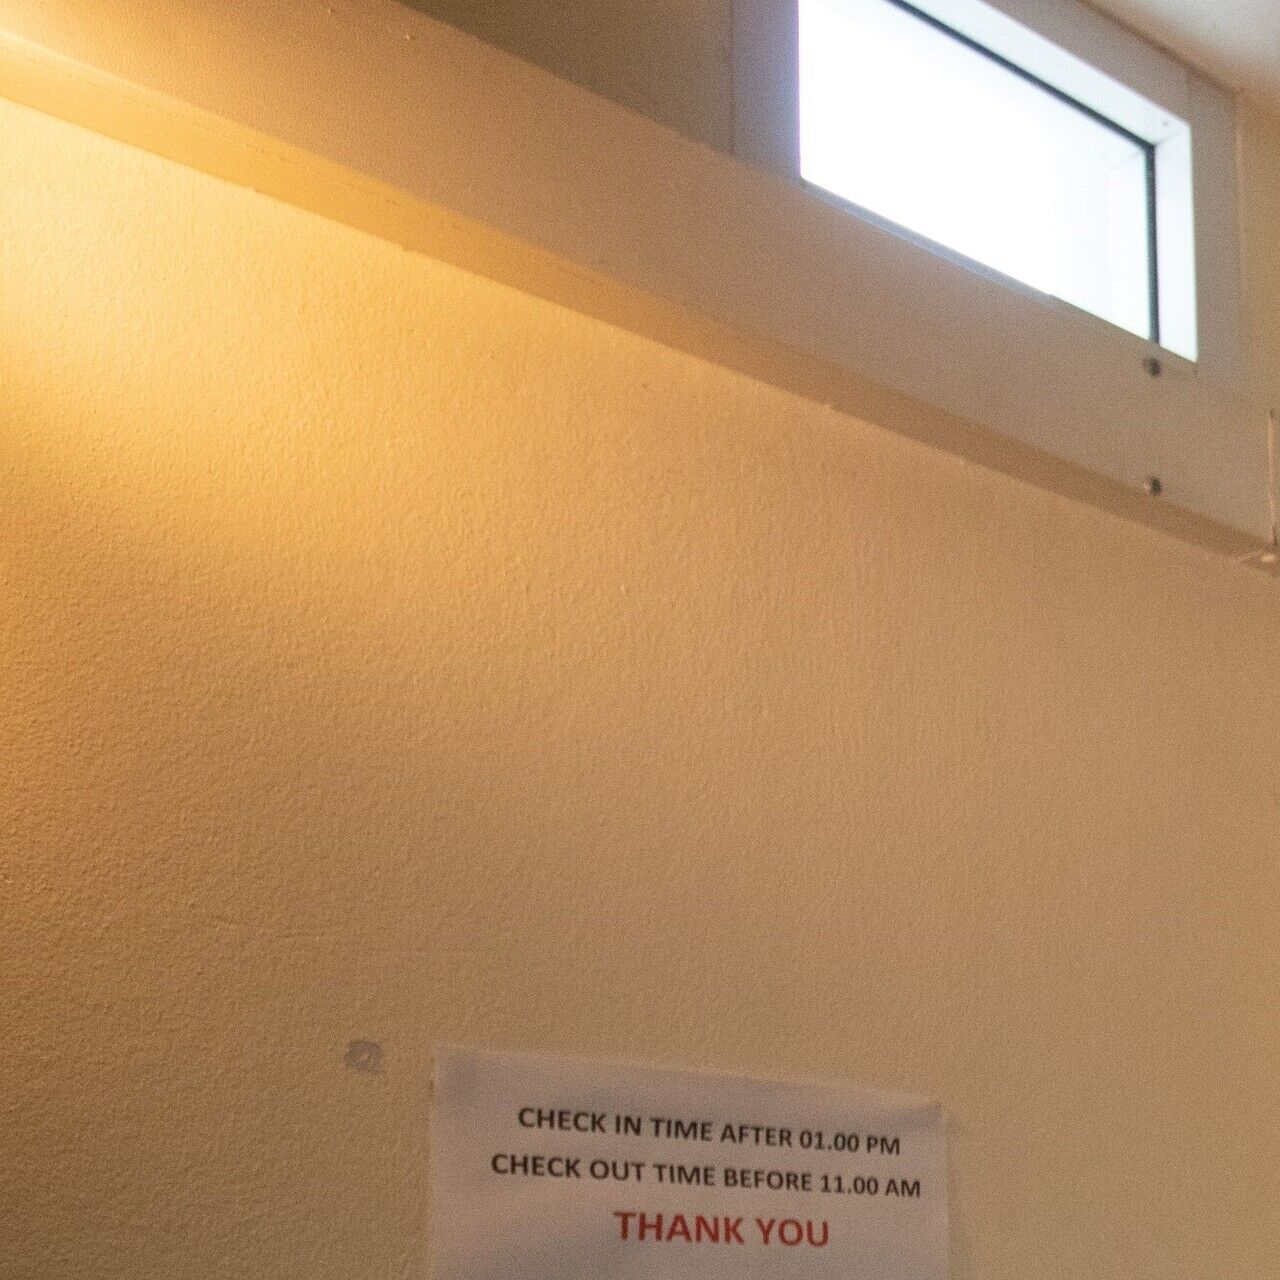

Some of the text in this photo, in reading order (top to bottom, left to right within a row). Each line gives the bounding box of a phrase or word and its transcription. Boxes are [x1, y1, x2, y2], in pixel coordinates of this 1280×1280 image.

[518, 1107, 900, 1155] CHECK IN TIME AFTER 01.00 PM
[491, 1153, 920, 1198] CHECK OUT TIME BEFORE 11.00 AM
[613, 1211, 829, 1247] THANK YOU
